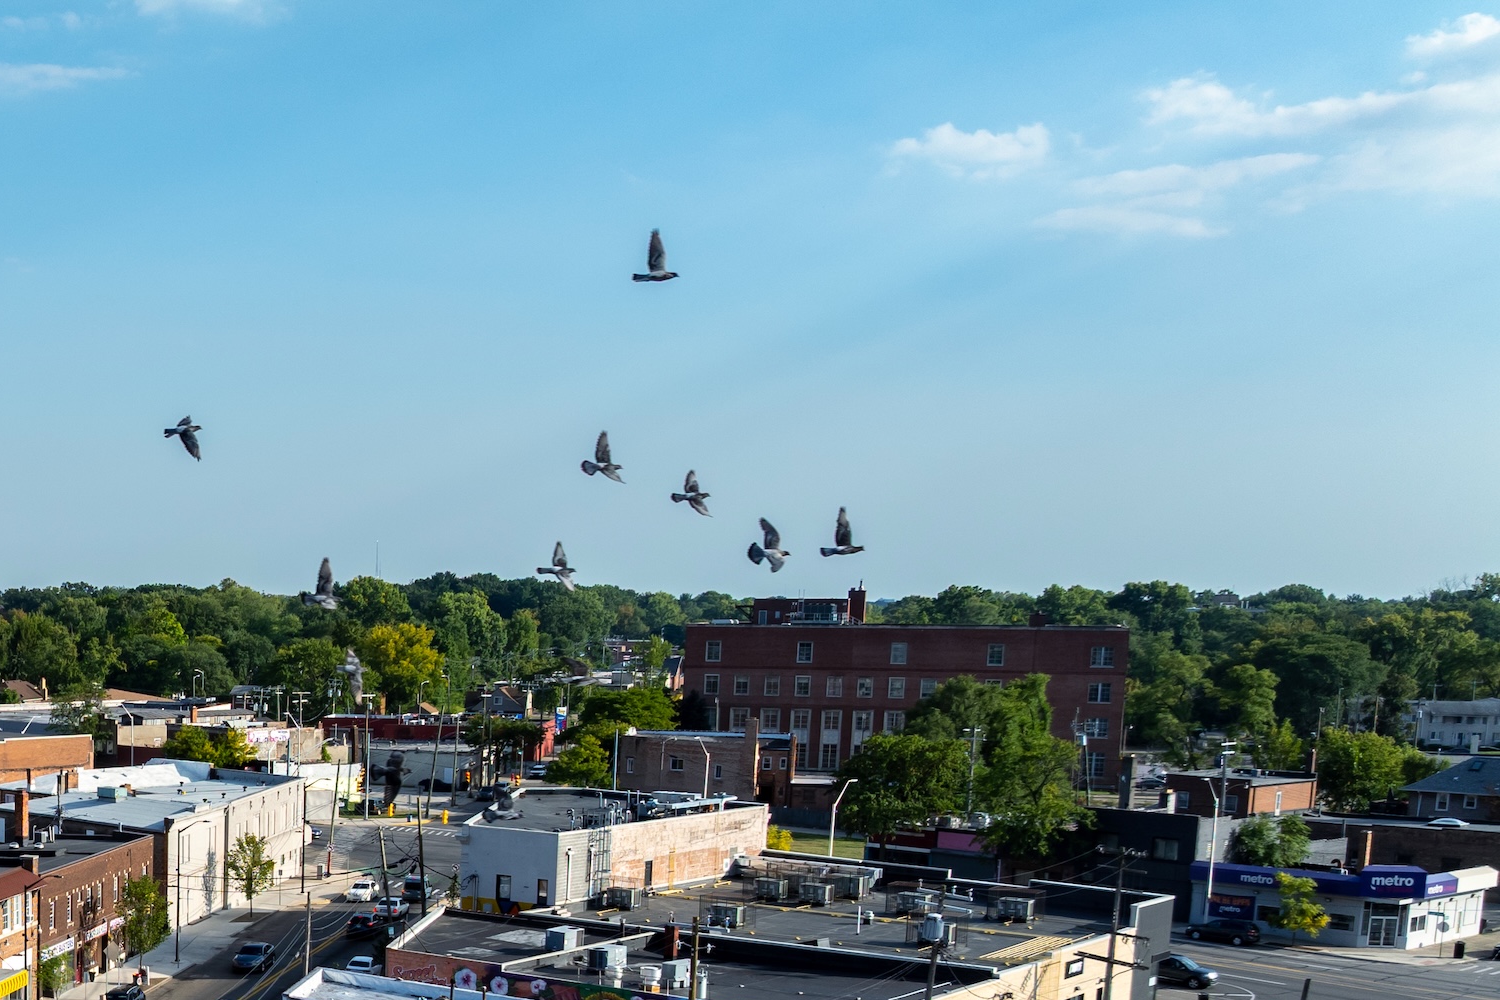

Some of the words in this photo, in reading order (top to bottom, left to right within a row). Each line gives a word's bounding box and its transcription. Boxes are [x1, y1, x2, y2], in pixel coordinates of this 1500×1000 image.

[1240, 874, 1274, 885] metro
[1371, 875, 1414, 888] metro
[1427, 884, 1444, 895] metro
[1218, 905, 1241, 913] metro
[391, 964, 436, 981] Sweet
